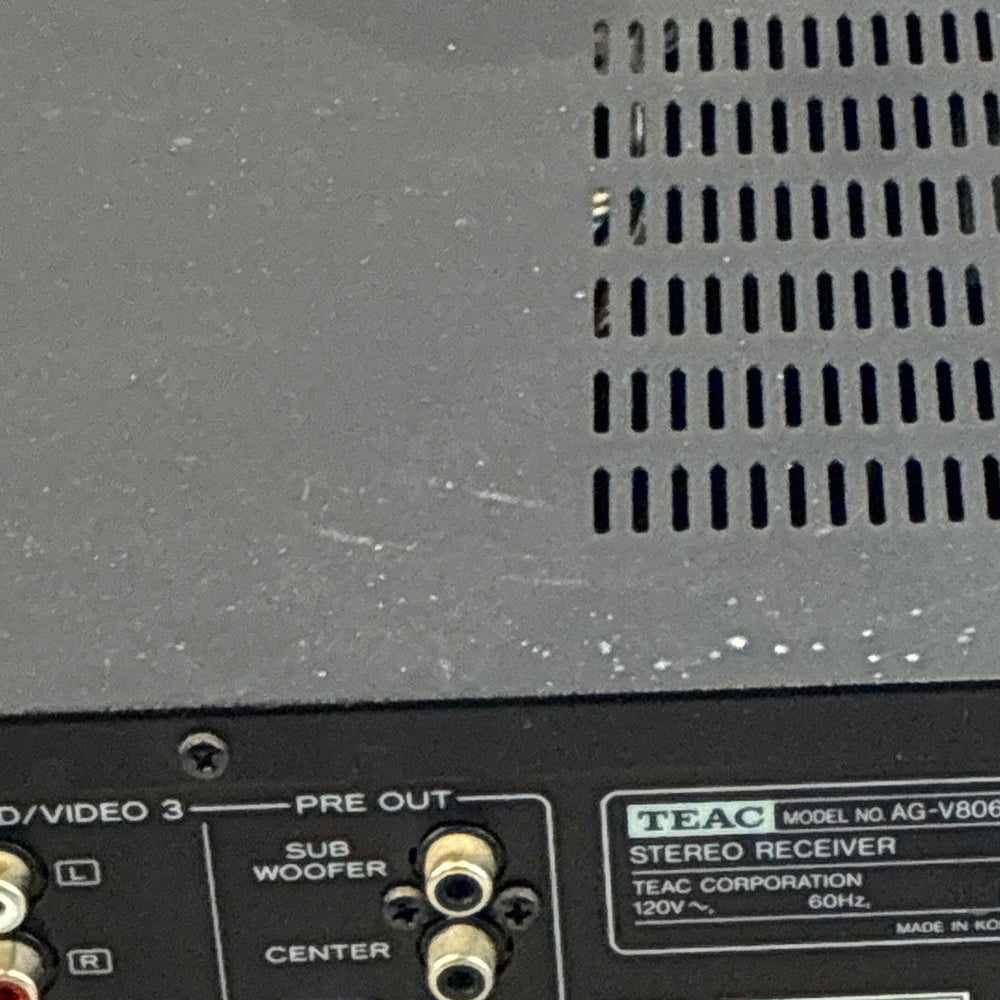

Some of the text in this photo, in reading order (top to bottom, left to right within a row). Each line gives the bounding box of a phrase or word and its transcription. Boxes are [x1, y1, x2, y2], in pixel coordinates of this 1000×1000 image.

[161, 799, 184, 821] 3
[296, 790, 452, 815] PRE OUT
[637, 806, 764, 831] TEAC
[783, 807, 849, 825] MODEL
[855, 806, 886, 822] NO.
[285, 841, 350, 859] SUB
[629, 836, 897, 865] STEREO RECEIVER
[69, 866, 87, 882] L
[253, 860, 388, 882] WOOFER
[632, 872, 863, 896] TEAC CORPORATION
[896, 920, 945, 934] MADE
[951, 920, 968, 932] IN
[79, 955, 100, 970] R
[265, 942, 391, 963] CENTER
